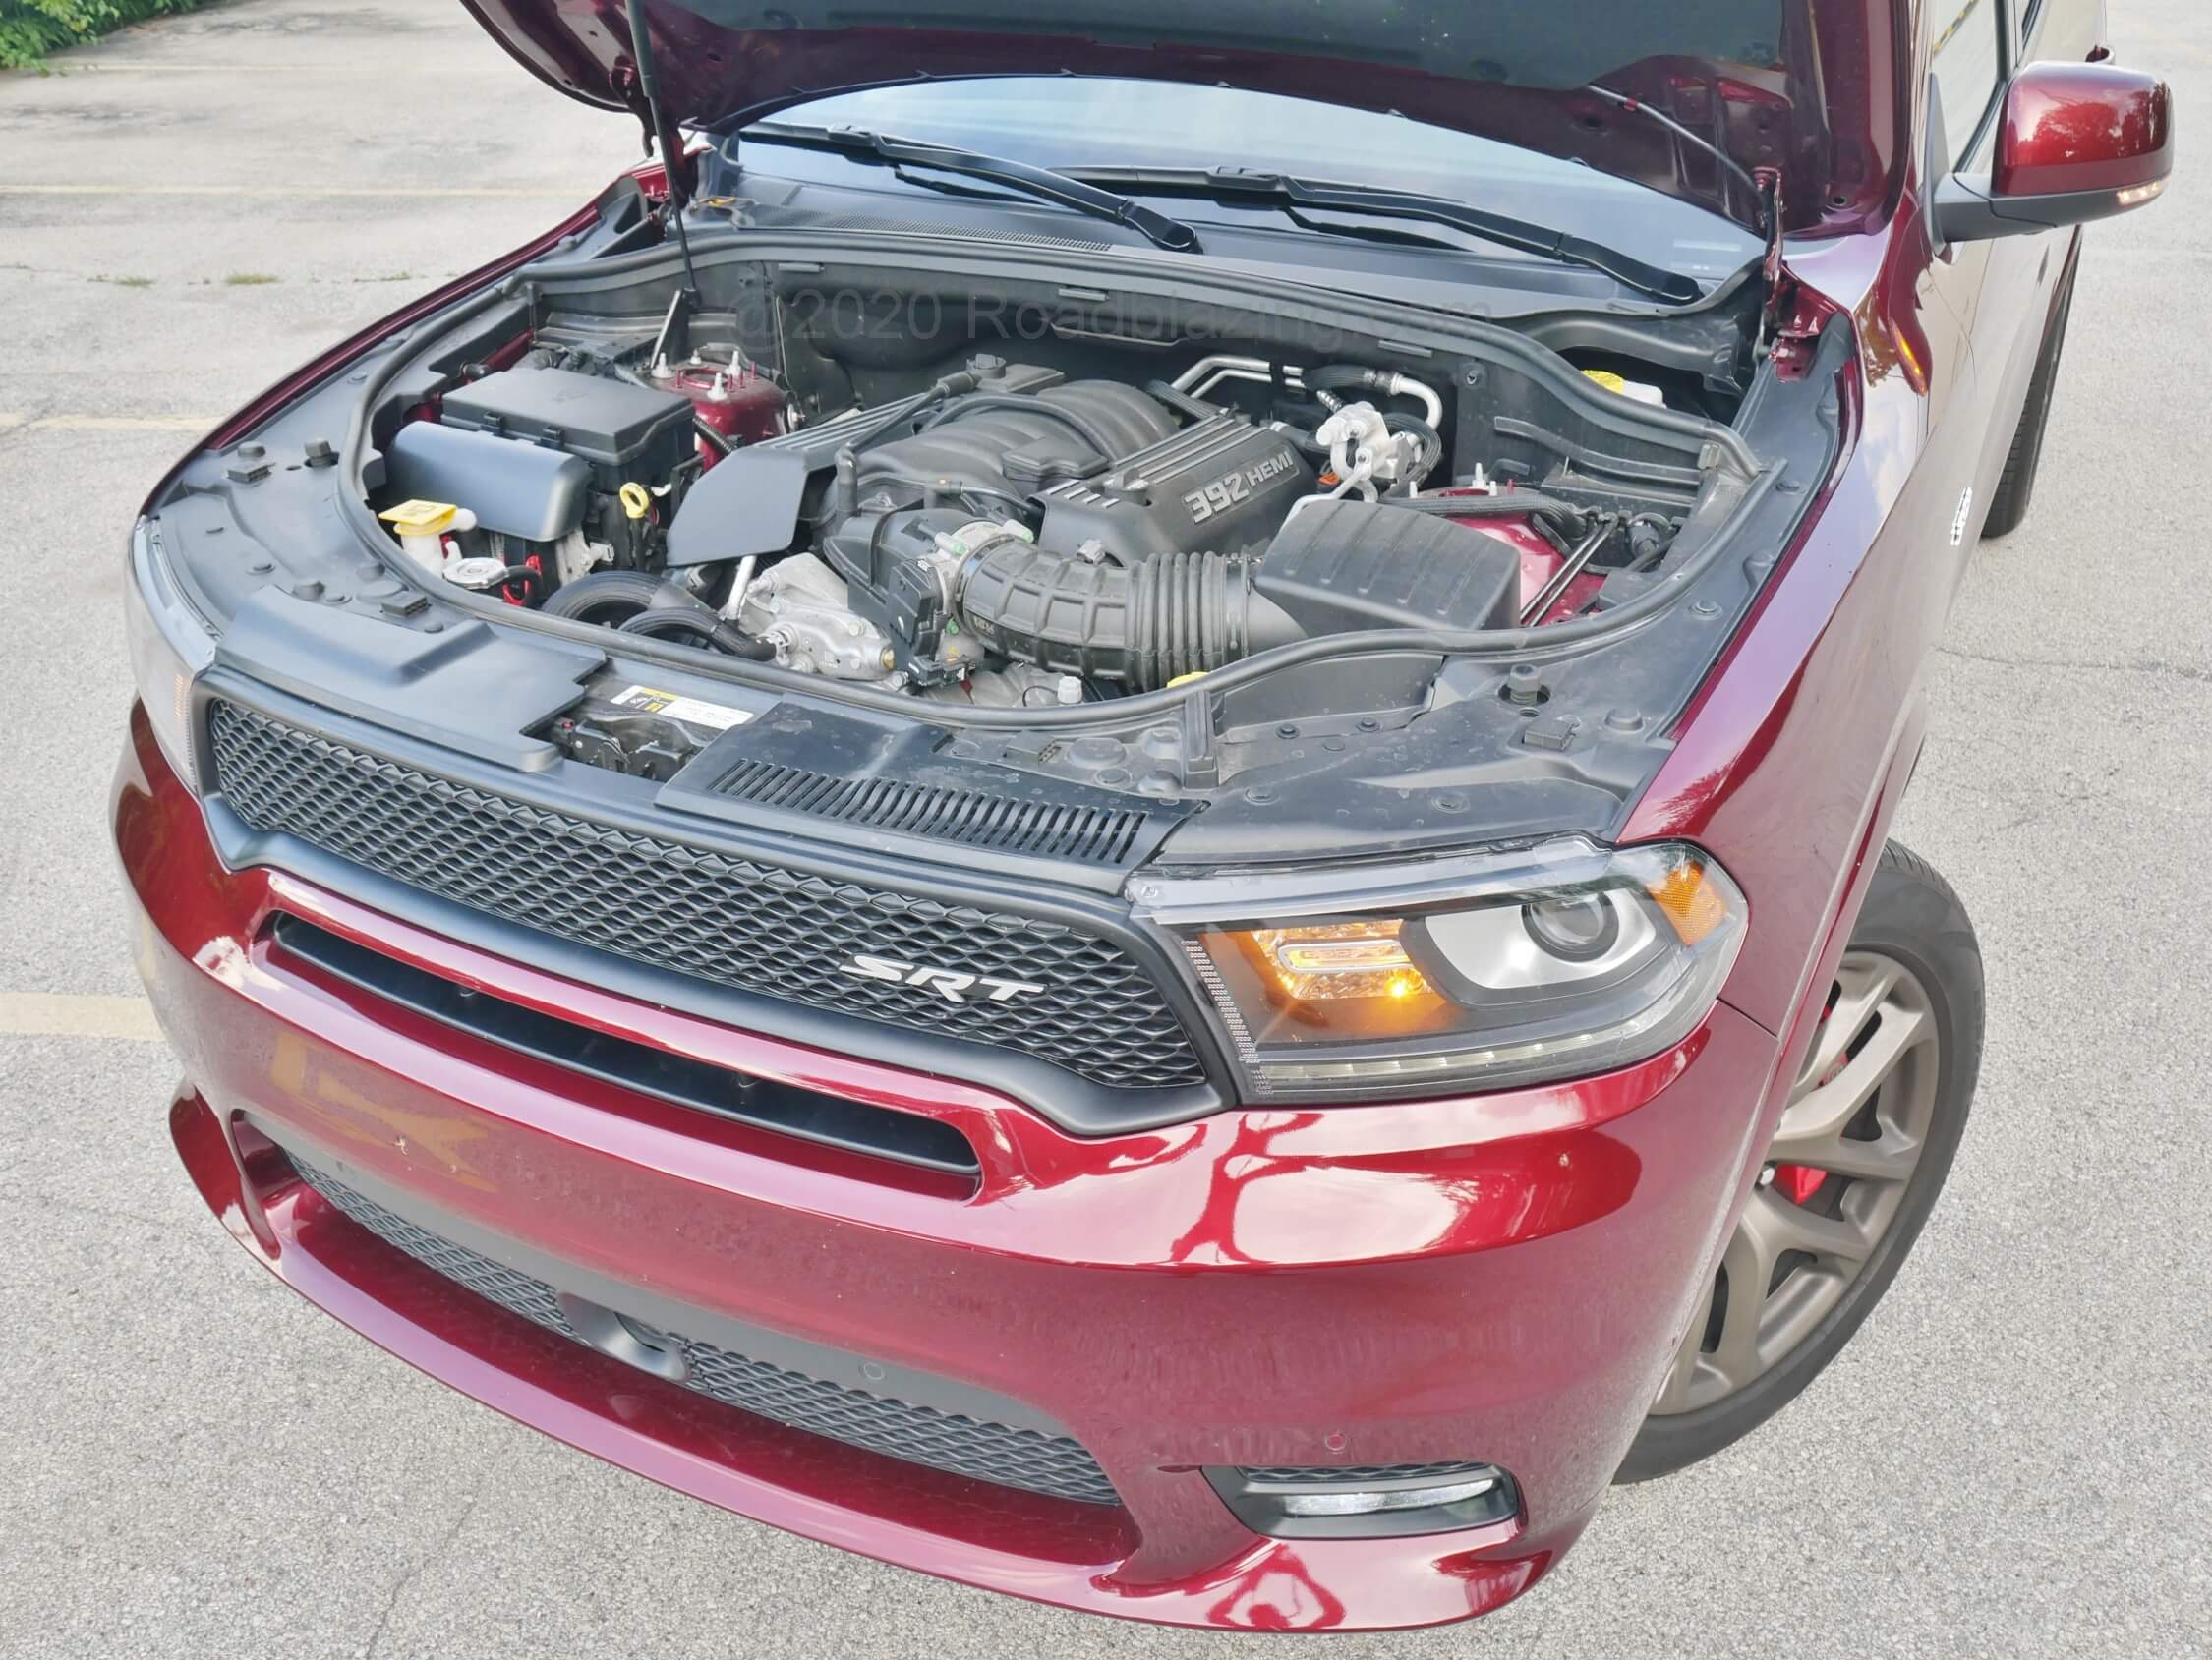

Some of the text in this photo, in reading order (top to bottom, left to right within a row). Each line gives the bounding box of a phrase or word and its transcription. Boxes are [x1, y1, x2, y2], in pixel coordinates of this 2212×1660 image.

[1185, 450, 1294, 524] 392 HEMI
[839, 955, 1045, 1003] SRT
